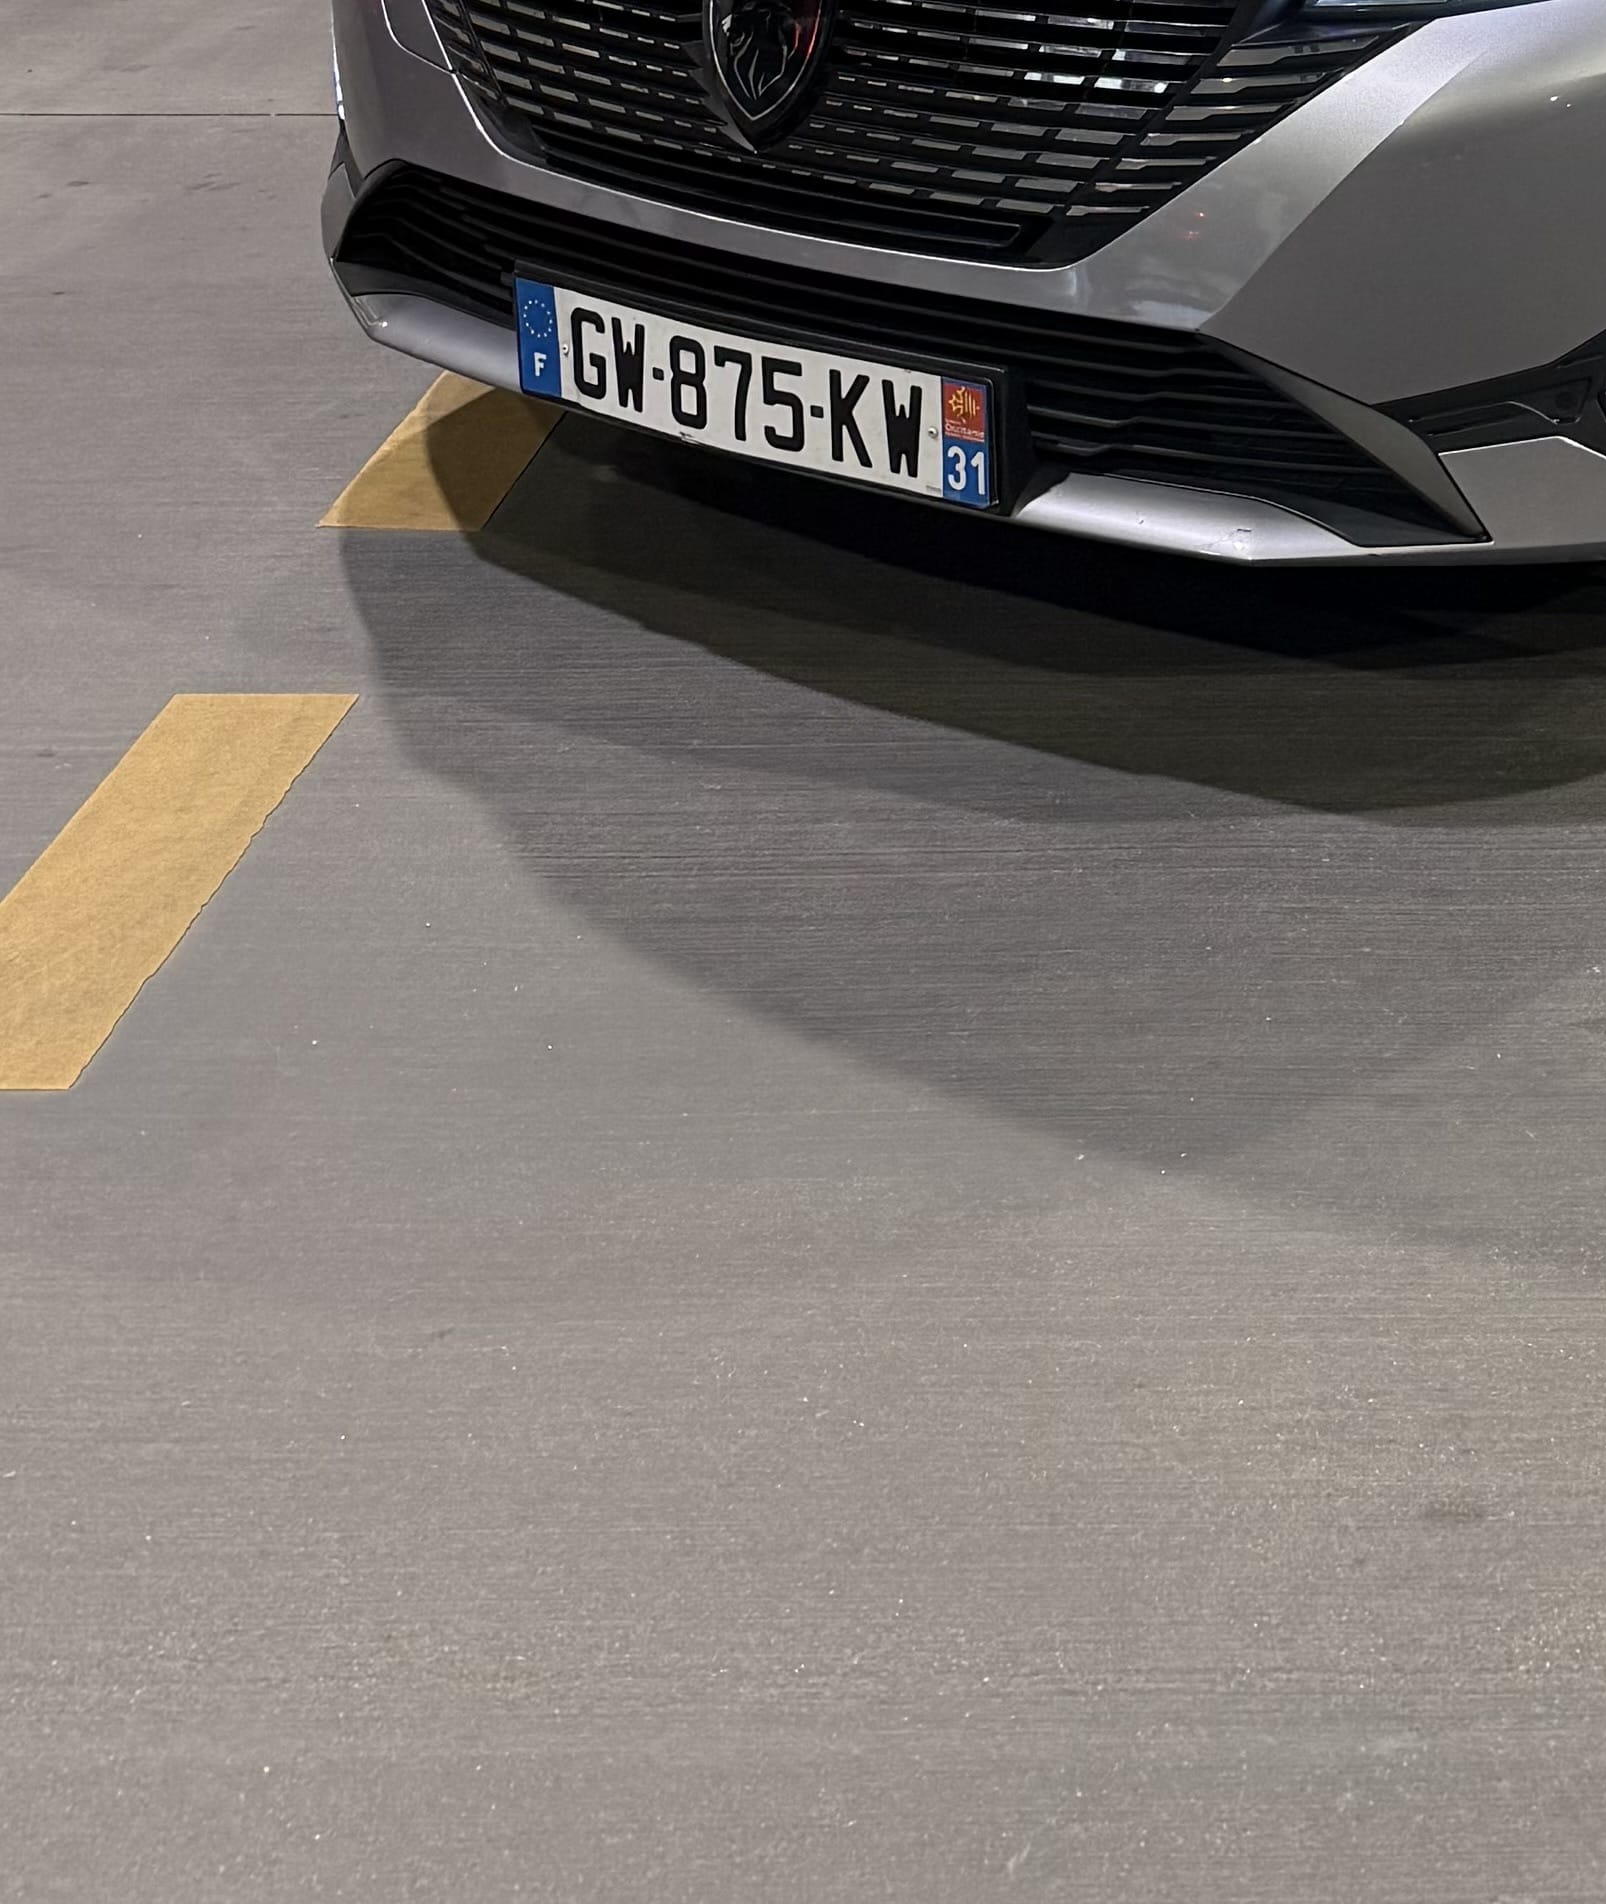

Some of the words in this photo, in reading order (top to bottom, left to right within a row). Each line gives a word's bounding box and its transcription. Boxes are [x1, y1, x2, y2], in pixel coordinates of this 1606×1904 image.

[533, 351, 547, 377] F
[570, 307, 922, 478] GW-875-KW
[947, 445, 986, 496] 31
